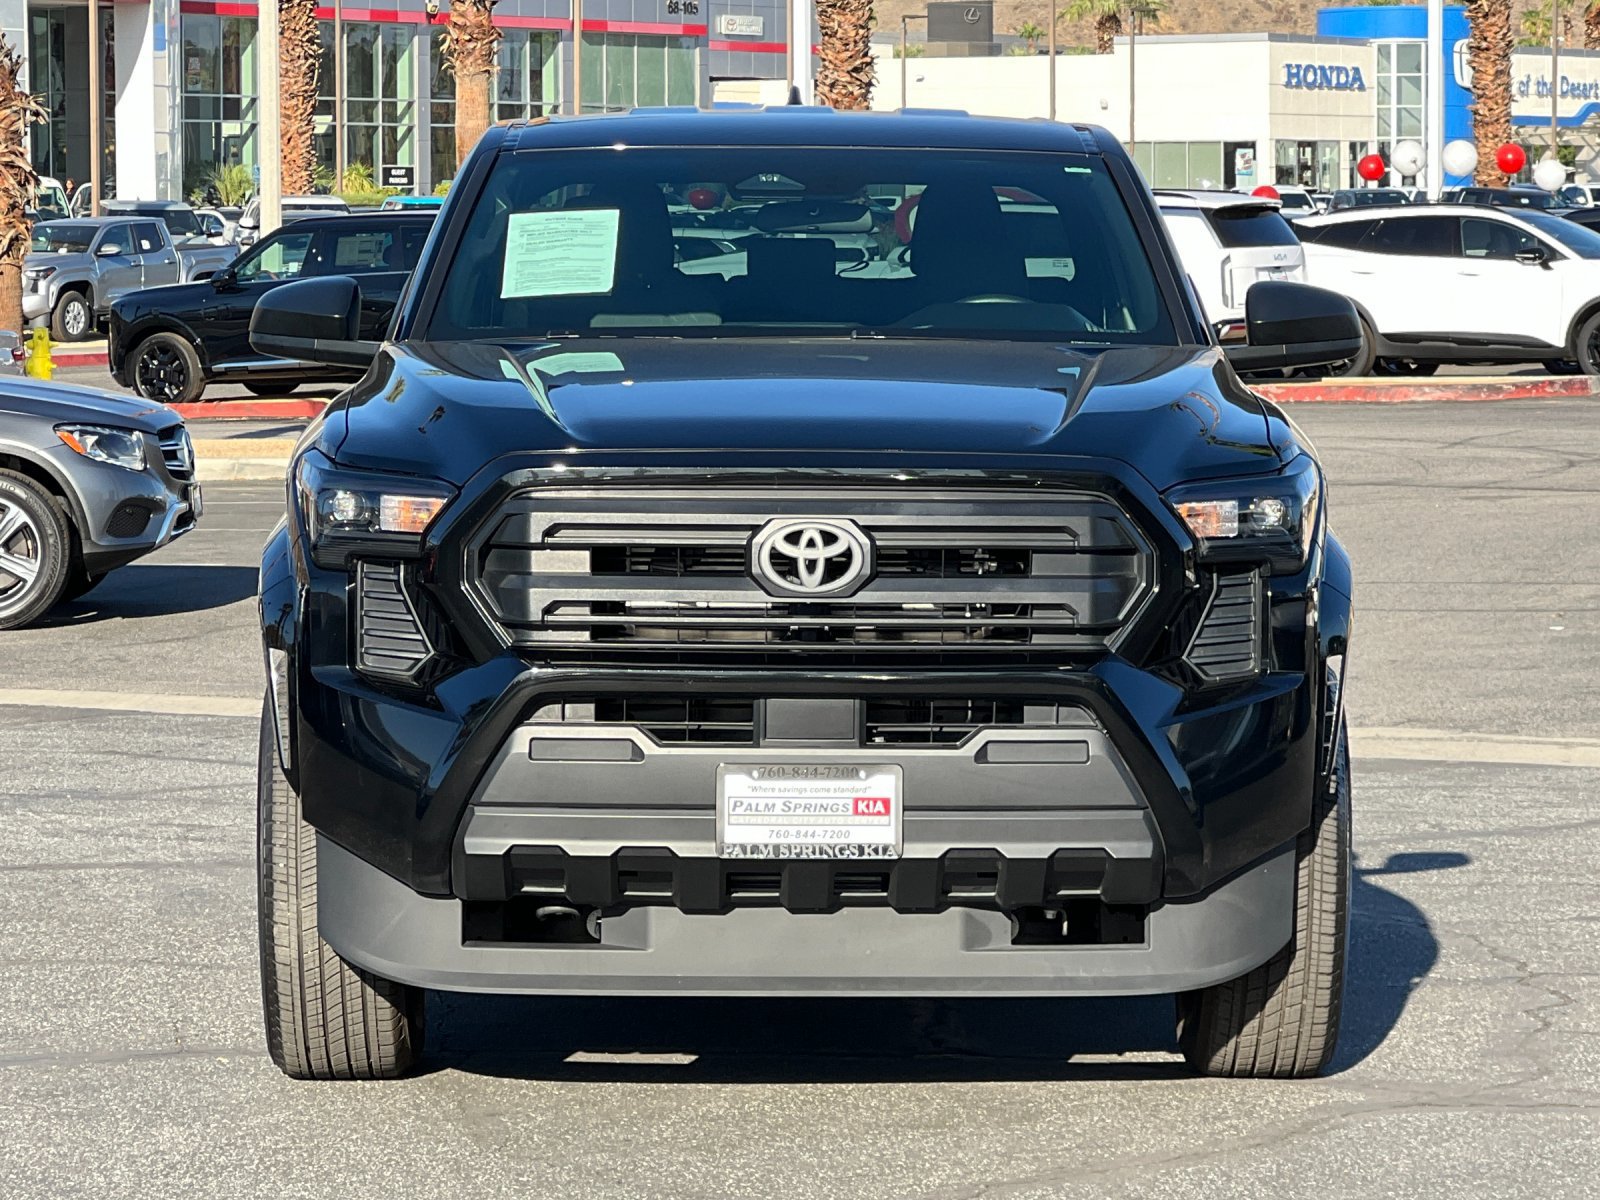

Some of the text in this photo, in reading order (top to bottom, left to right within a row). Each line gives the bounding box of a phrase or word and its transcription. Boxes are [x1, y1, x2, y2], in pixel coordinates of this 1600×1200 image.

[668, 1, 698, 15] 68-105
[1284, 63, 1367, 92] HONDA
[1518, 74, 1531, 98] of
[1560, 75, 1600, 99] Desert
[758, 766, 859, 779] 760-844-7200
[777, 786, 808, 795] savings
[731, 799, 885, 813] PALM SPRINGS KIA
[768, 829, 851, 839] 760-844-7200
[722, 844, 898, 858] PALM SPRINGS KIA
